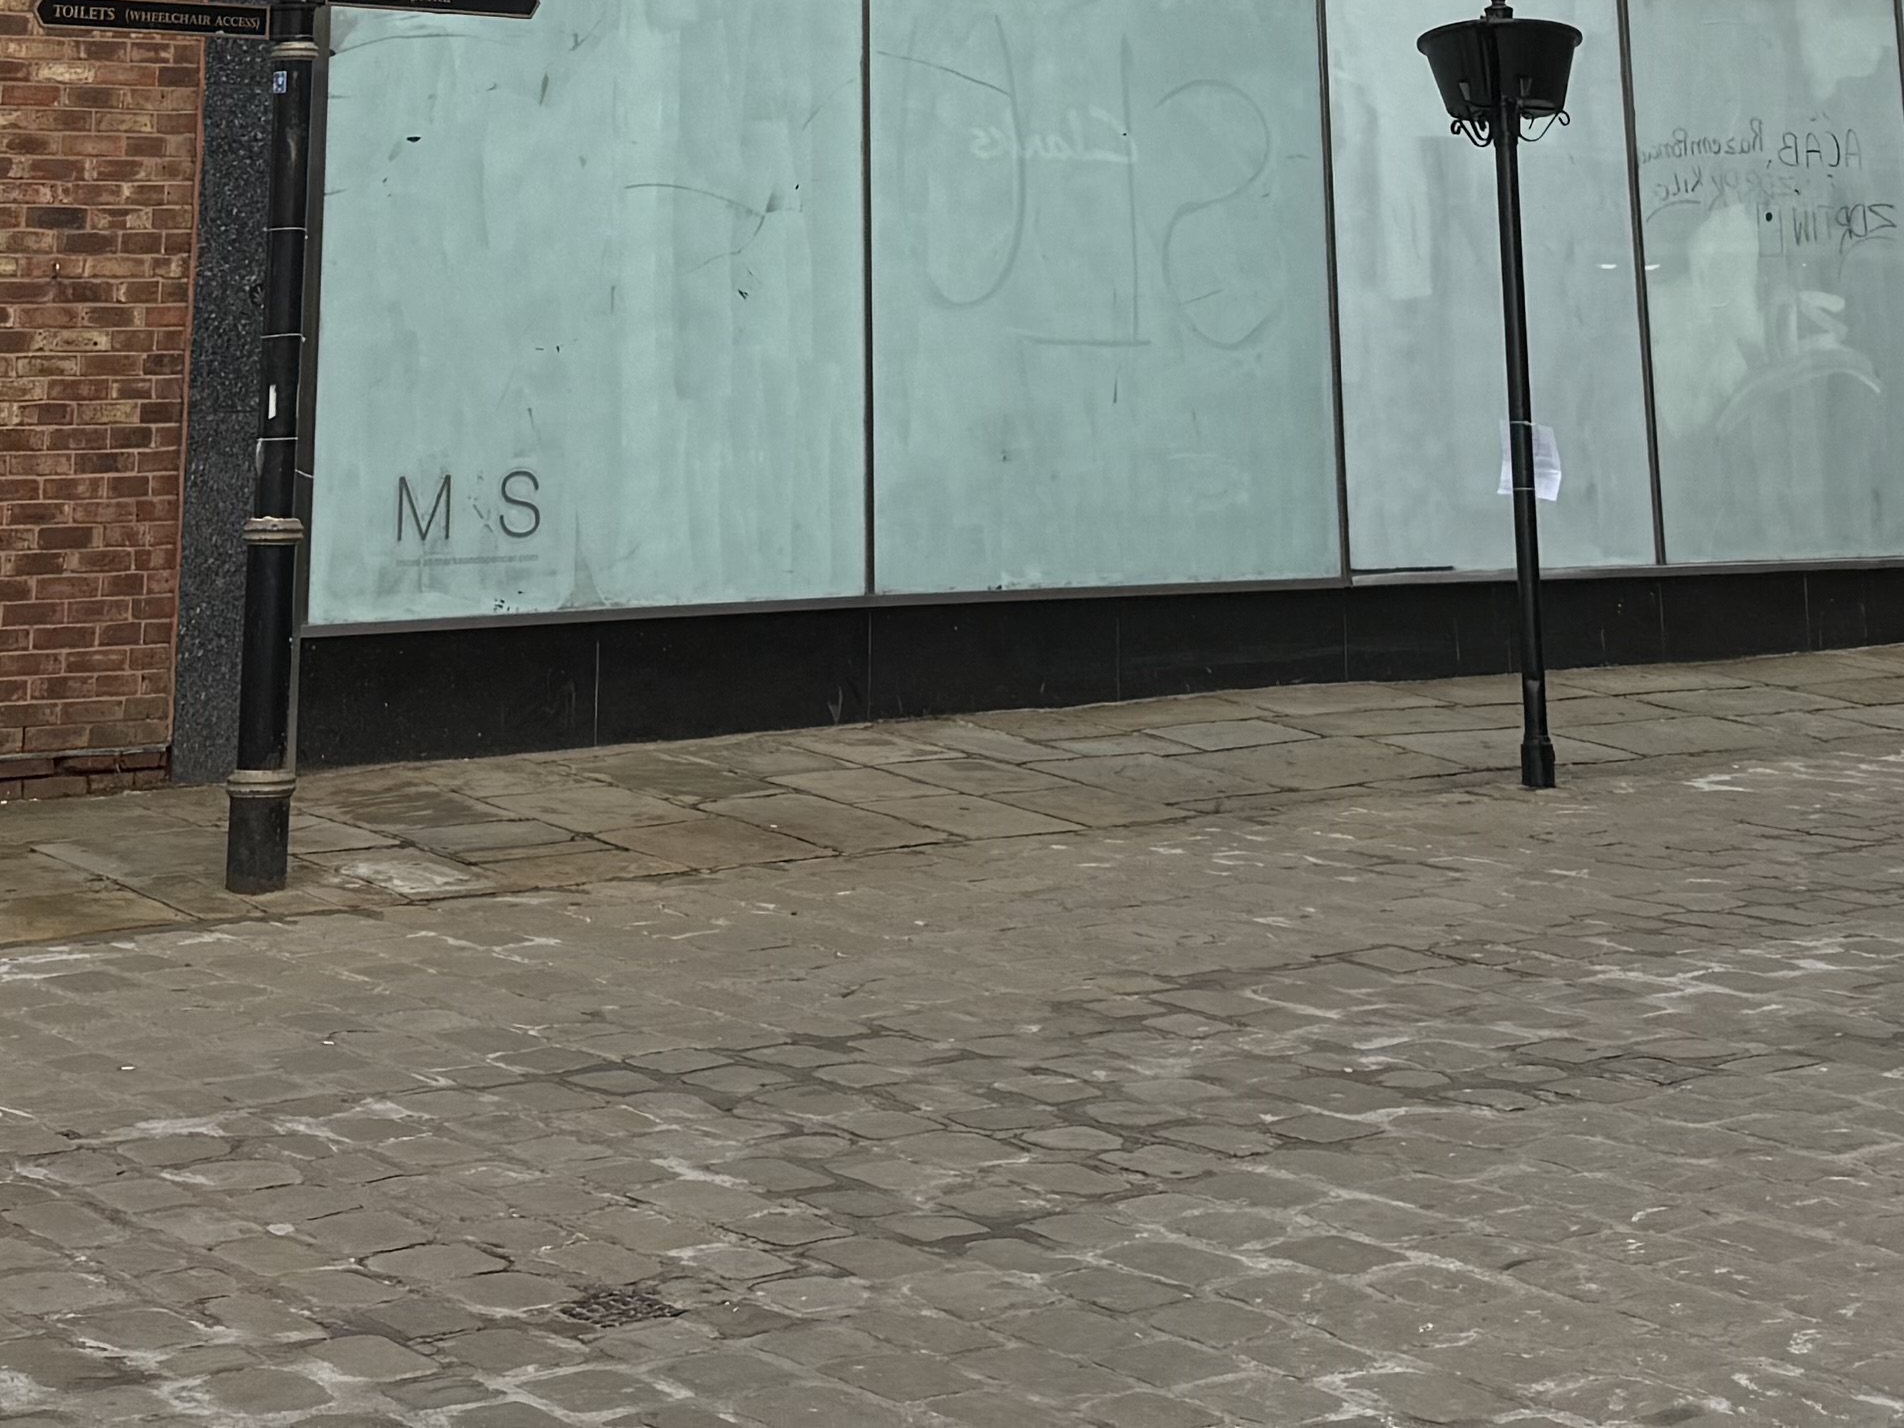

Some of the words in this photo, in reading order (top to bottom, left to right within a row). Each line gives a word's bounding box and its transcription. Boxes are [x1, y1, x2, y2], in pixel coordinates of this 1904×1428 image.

[52, 3, 115, 21] TOILETS
[125, 8, 210, 27] (WHEELCHAIR
[214, 14, 261, 31] ACCESS)
[397, 470, 540, 542] MS
